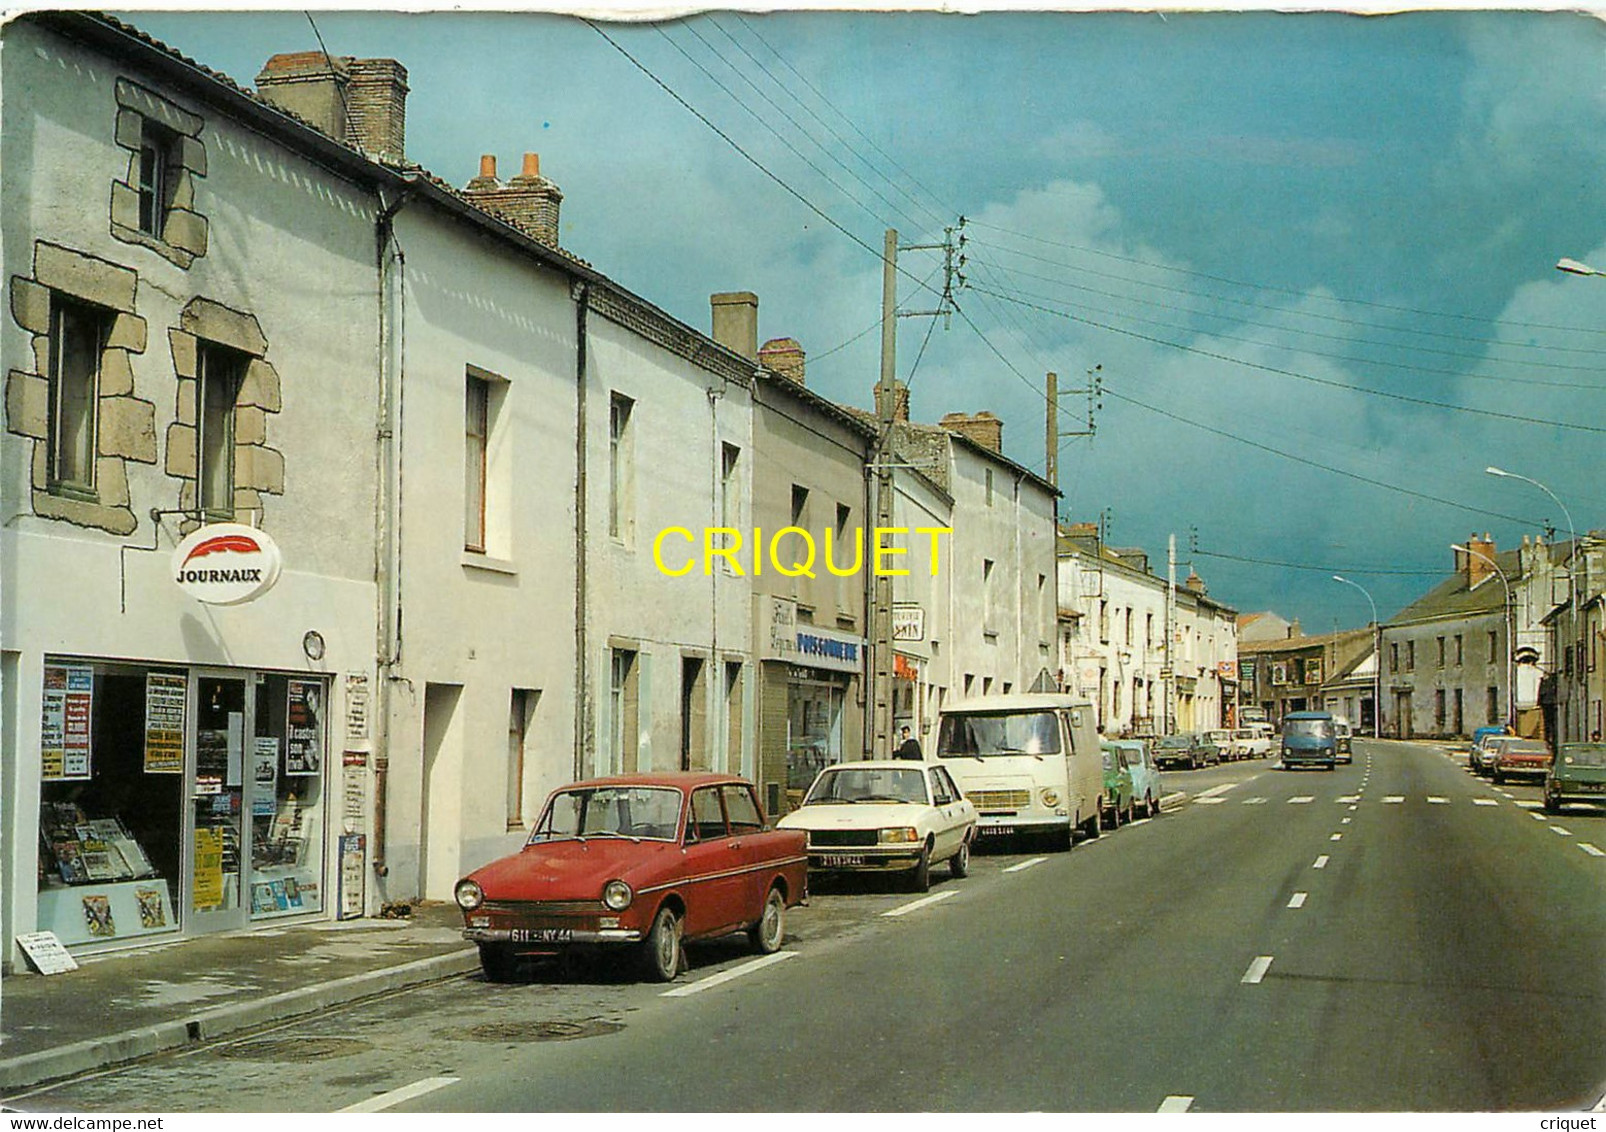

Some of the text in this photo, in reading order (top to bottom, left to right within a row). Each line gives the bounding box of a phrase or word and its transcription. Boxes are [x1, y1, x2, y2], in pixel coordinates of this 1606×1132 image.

[176, 569, 262, 583] JOURNAUX
[511, 929, 529, 942] 611
[557, 929, 571, 941] 44
